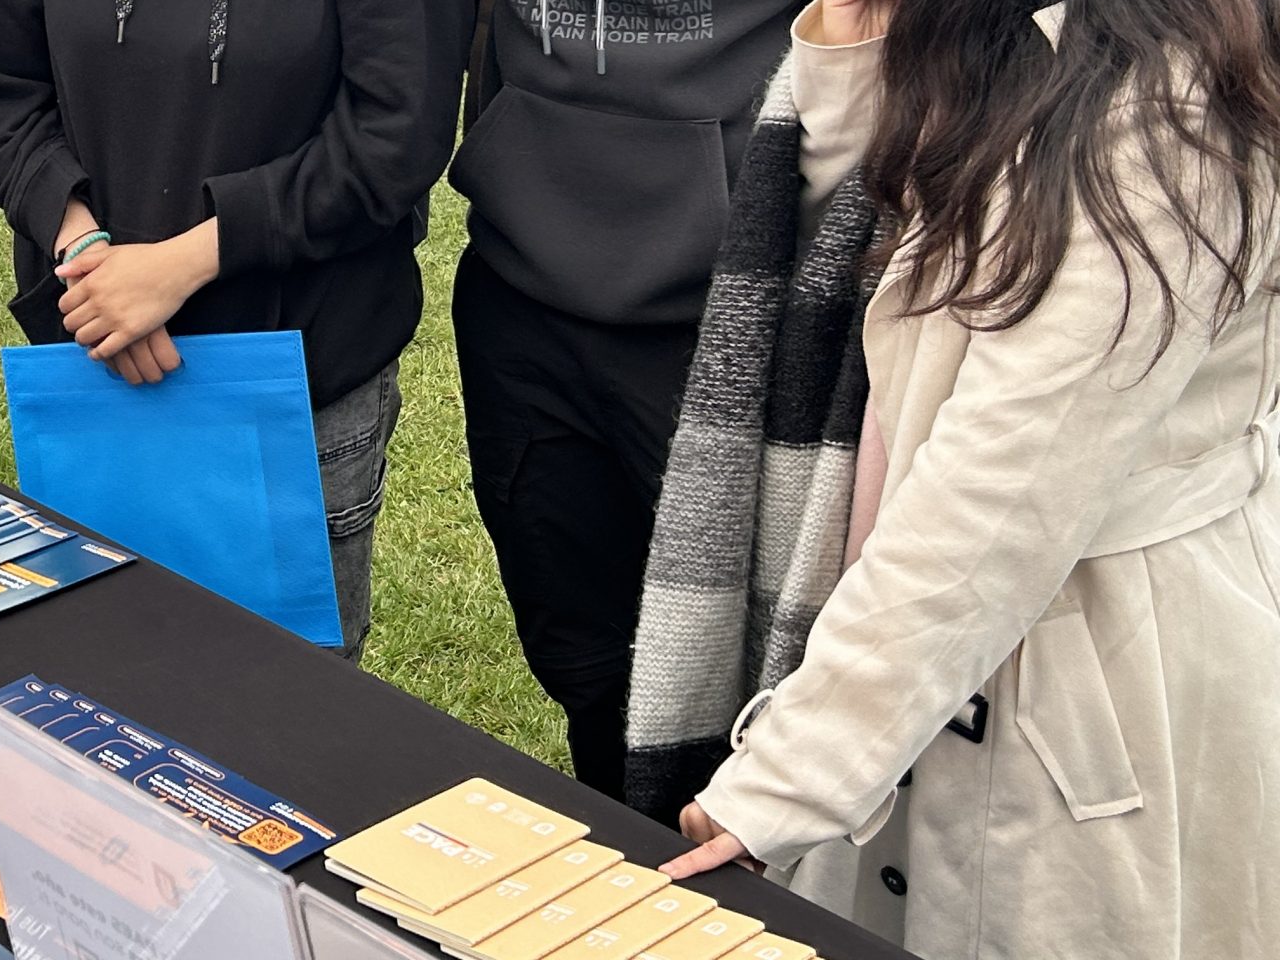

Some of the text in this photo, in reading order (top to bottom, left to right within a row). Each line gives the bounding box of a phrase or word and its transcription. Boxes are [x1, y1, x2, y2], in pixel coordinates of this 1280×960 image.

[530, 6, 588, 28] MODE
[654, 12, 713, 32] MODE
[528, 23, 586, 41] TAIN
[653, 26, 714, 45] TRAIN
[400, 823, 465, 857] PACE
